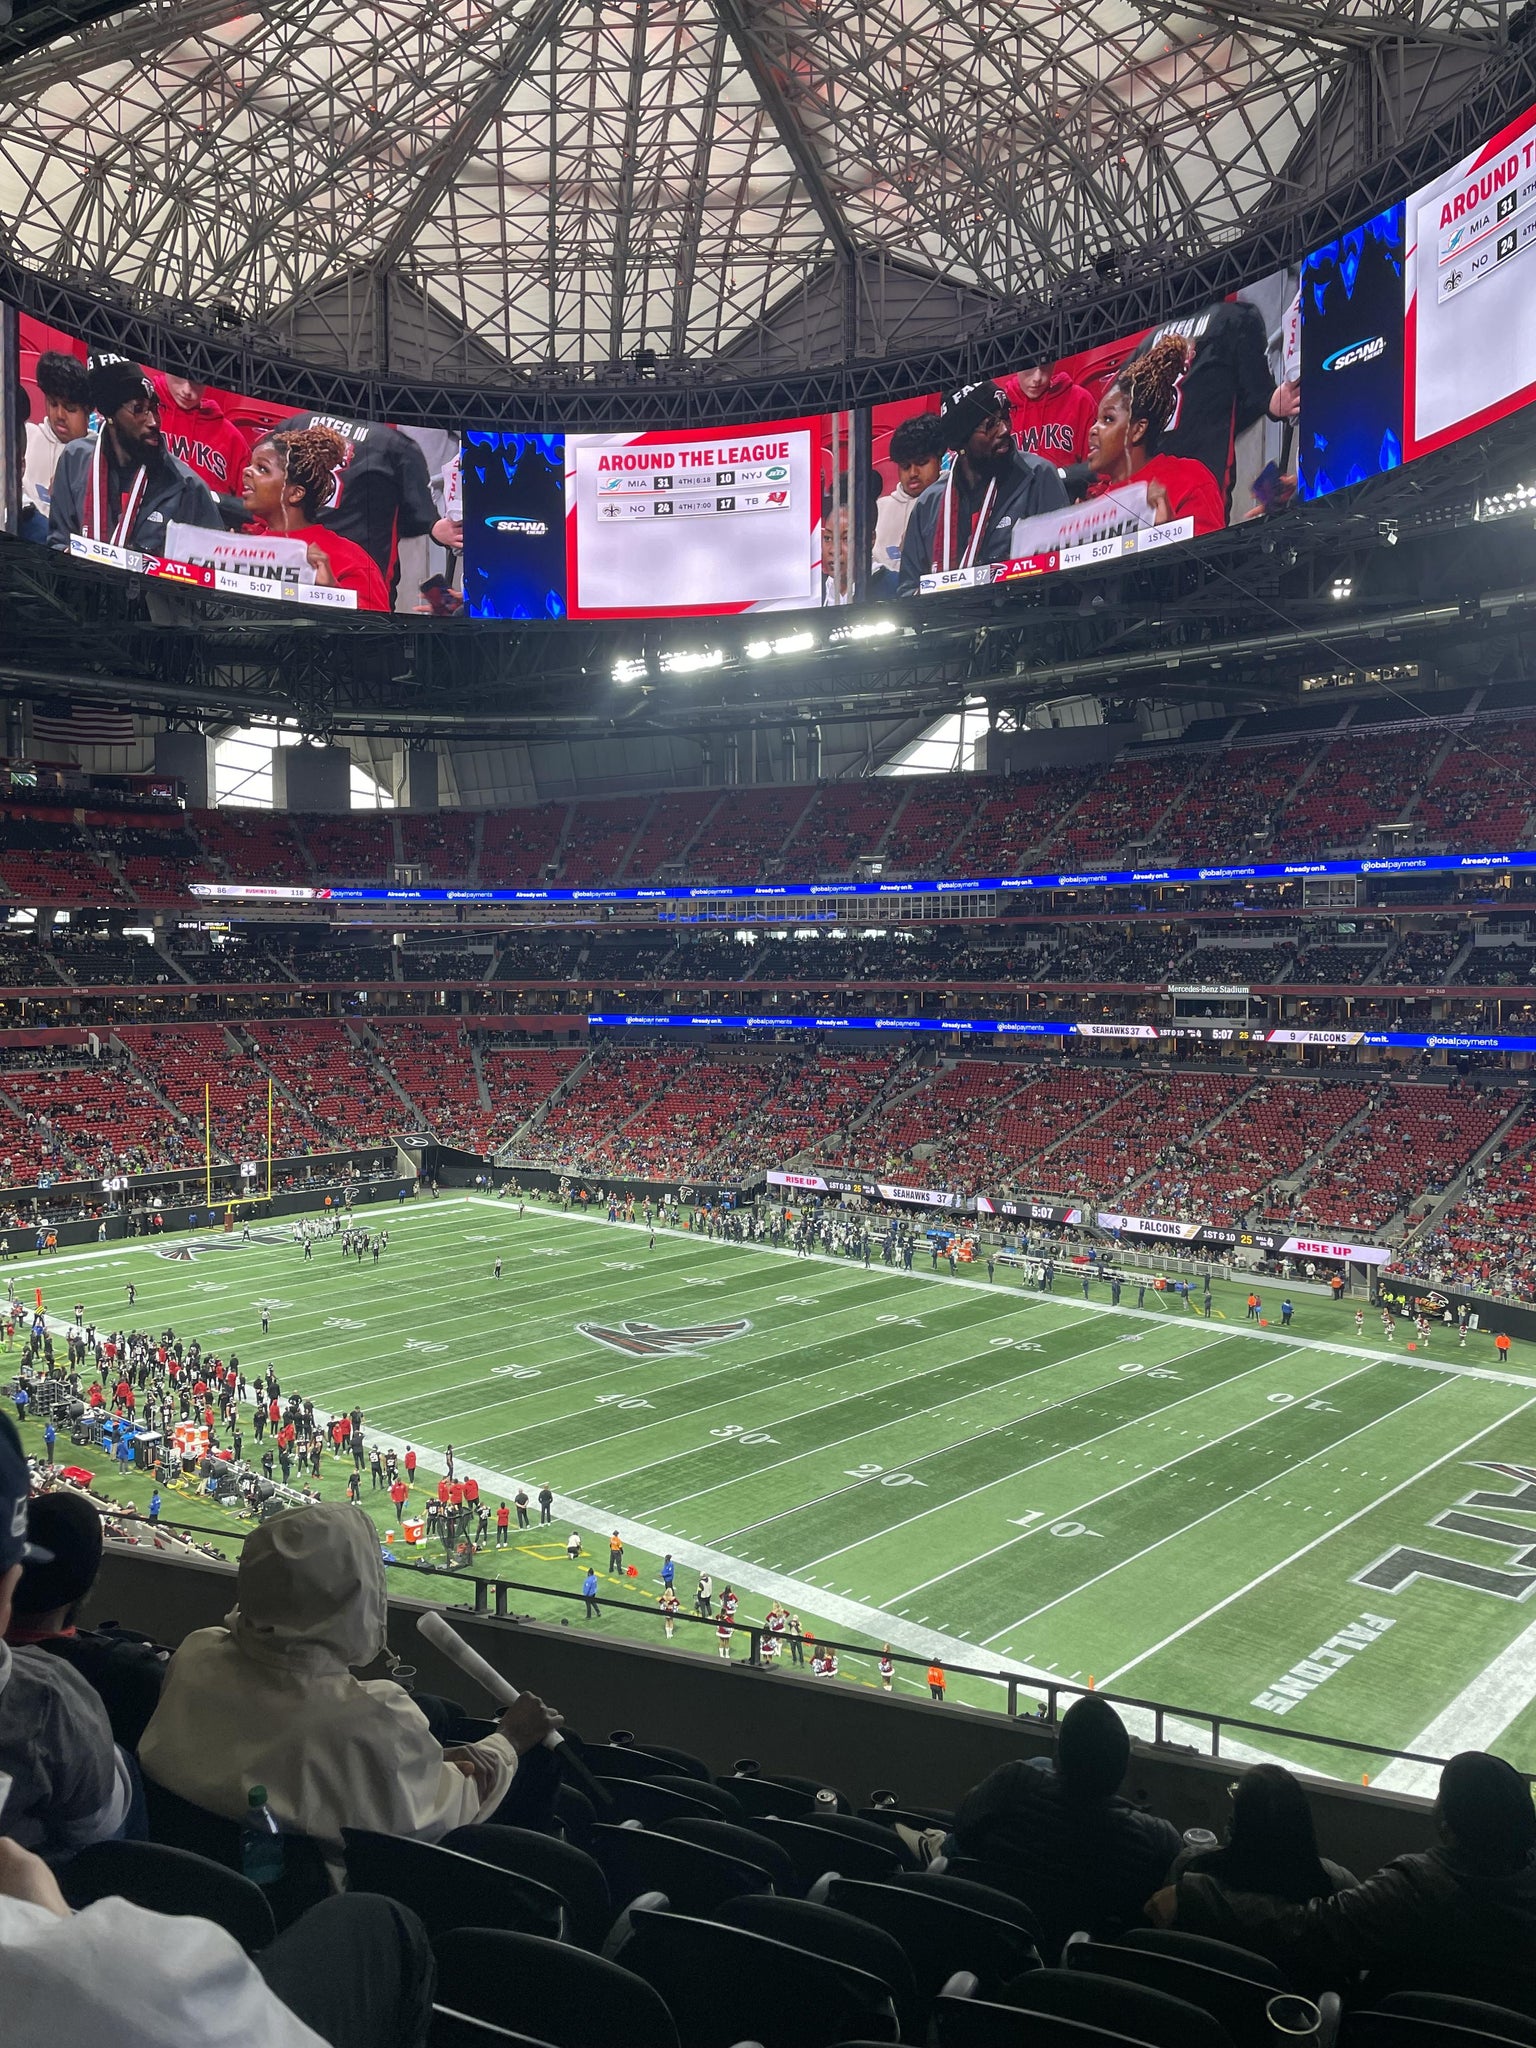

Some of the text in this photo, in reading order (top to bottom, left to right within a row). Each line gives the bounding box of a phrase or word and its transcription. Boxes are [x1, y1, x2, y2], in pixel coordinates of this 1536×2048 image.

[1440, 136, 1536, 230] AROUND T
[1470, 215, 1490, 235] MIA
[1501, 196, 1514, 216] 31
[1471, 254, 1489, 272] NO
[1501, 235, 1514, 255] 24
[353, 426, 370, 442] III
[598, 442, 790, 472] AROUND THE LEAGUE
[627, 479, 648, 488] MIA
[657, 477, 670, 488] 31
[678, 477, 693, 485] 4TH
[719, 473, 732, 483] 10
[742, 471, 763, 481] NYJ
[630, 497, 759, 513] NO 24 4TH 7:00 17 TB
[213, 545, 276, 560] ATLANTA
[942, 573, 967, 584] SEA
[977, 569, 987, 581] 37
[1012, 560, 1037, 572] ATL
[1049, 556, 1056, 567] 9
[1064, 553, 1081, 563] 4TH
[1092, 544, 1113, 558] 5:07
[1124, 539, 1135, 549] 25
[1148, 532, 1164, 543] 1ST
[1173, 527, 1182, 536] 10
[92, 544, 118, 560] SEA
[128, 554, 141, 567] 37
[165, 562, 191, 577] ATL
[204, 571, 211, 583] 9
[220, 576, 238, 588] 4TH
[250, 580, 273, 594] 5:07
[309, 590, 326, 600] 1ST
[335, 593, 346, 602] 10
[1361, 860, 1426, 871] globalpayments
[1461, 857, 1491, 865] Already
[1199, 868, 1255, 879] globalpayments
[1285, 866, 1310, 874] Already
[936, 882, 979, 891] globalpayments
[1058, 875, 1108, 886] globalpayments
[217, 887, 227, 895] 86
[447, 891, 492, 899] globalpayments
[690, 888, 733, 896] globalpayments
[810, 884, 856, 894] globalpayments
[1168, 984, 1219, 993] Mercedes-Benz
[1220, 985, 1250, 994] Stadium
[626, 1016, 670, 1024] globalpayments
[747, 1017, 792, 1026] globalpayments
[876, 1019, 920, 1028] globalpayments
[997, 1022, 1044, 1032] globalpayments
[1092, 1026, 1140, 1036] SEAHAWKS 37
[1212, 1030, 1233, 1040] 5:07
[1290, 1032, 1346, 1043] 9 FALCONS
[1426, 1036, 1498, 1048] globalpayments
[102, 1178, 128, 1192] 5:07
[786, 1176, 818, 1186] RISE UP
[893, 1188, 947, 1204] SEAHAWKS 37
[1002, 1204, 1054, 1219] 4TH 5:07
[1122, 1217, 1181, 1235] 9 FALCONS
[1203, 1230, 1218, 1239] 1ST
[1226, 1232, 1236, 1242] 10
[1240, 1234, 1252, 1244] 25
[1267, 1237, 1274, 1248] 4
[1297, 1242, 1352, 1256] RISE UP
[491, 1363, 542, 1380] 50
[1118, 1362, 1177, 1380] 20
[595, 1392, 648, 1410] 40
[1266, 1392, 1329, 1413] 10
[710, 1424, 767, 1446] 30
[843, 1463, 912, 1488] 20
[1006, 1508, 1085, 1539] 10
[413, 1526, 422, 1538] G
[1250, 1612, 1397, 1716] FALCONS
